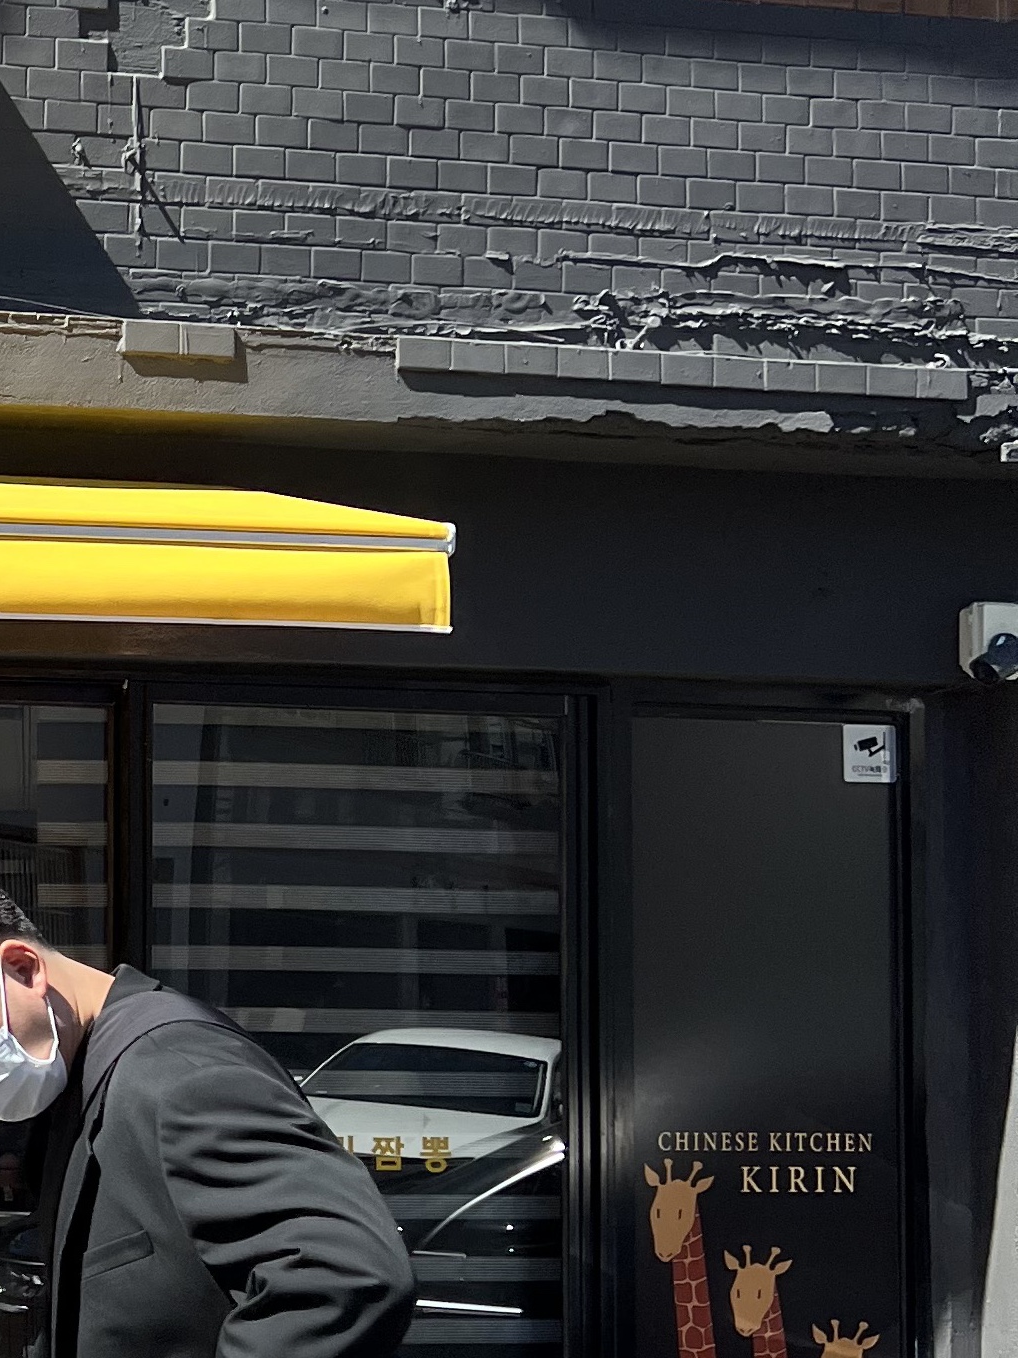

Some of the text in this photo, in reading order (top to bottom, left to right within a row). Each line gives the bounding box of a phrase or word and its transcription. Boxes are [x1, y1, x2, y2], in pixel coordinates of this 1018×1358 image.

[657, 1130, 874, 1154] CHINESE KITCHEN
[740, 1165, 858, 1194] KIRIN
